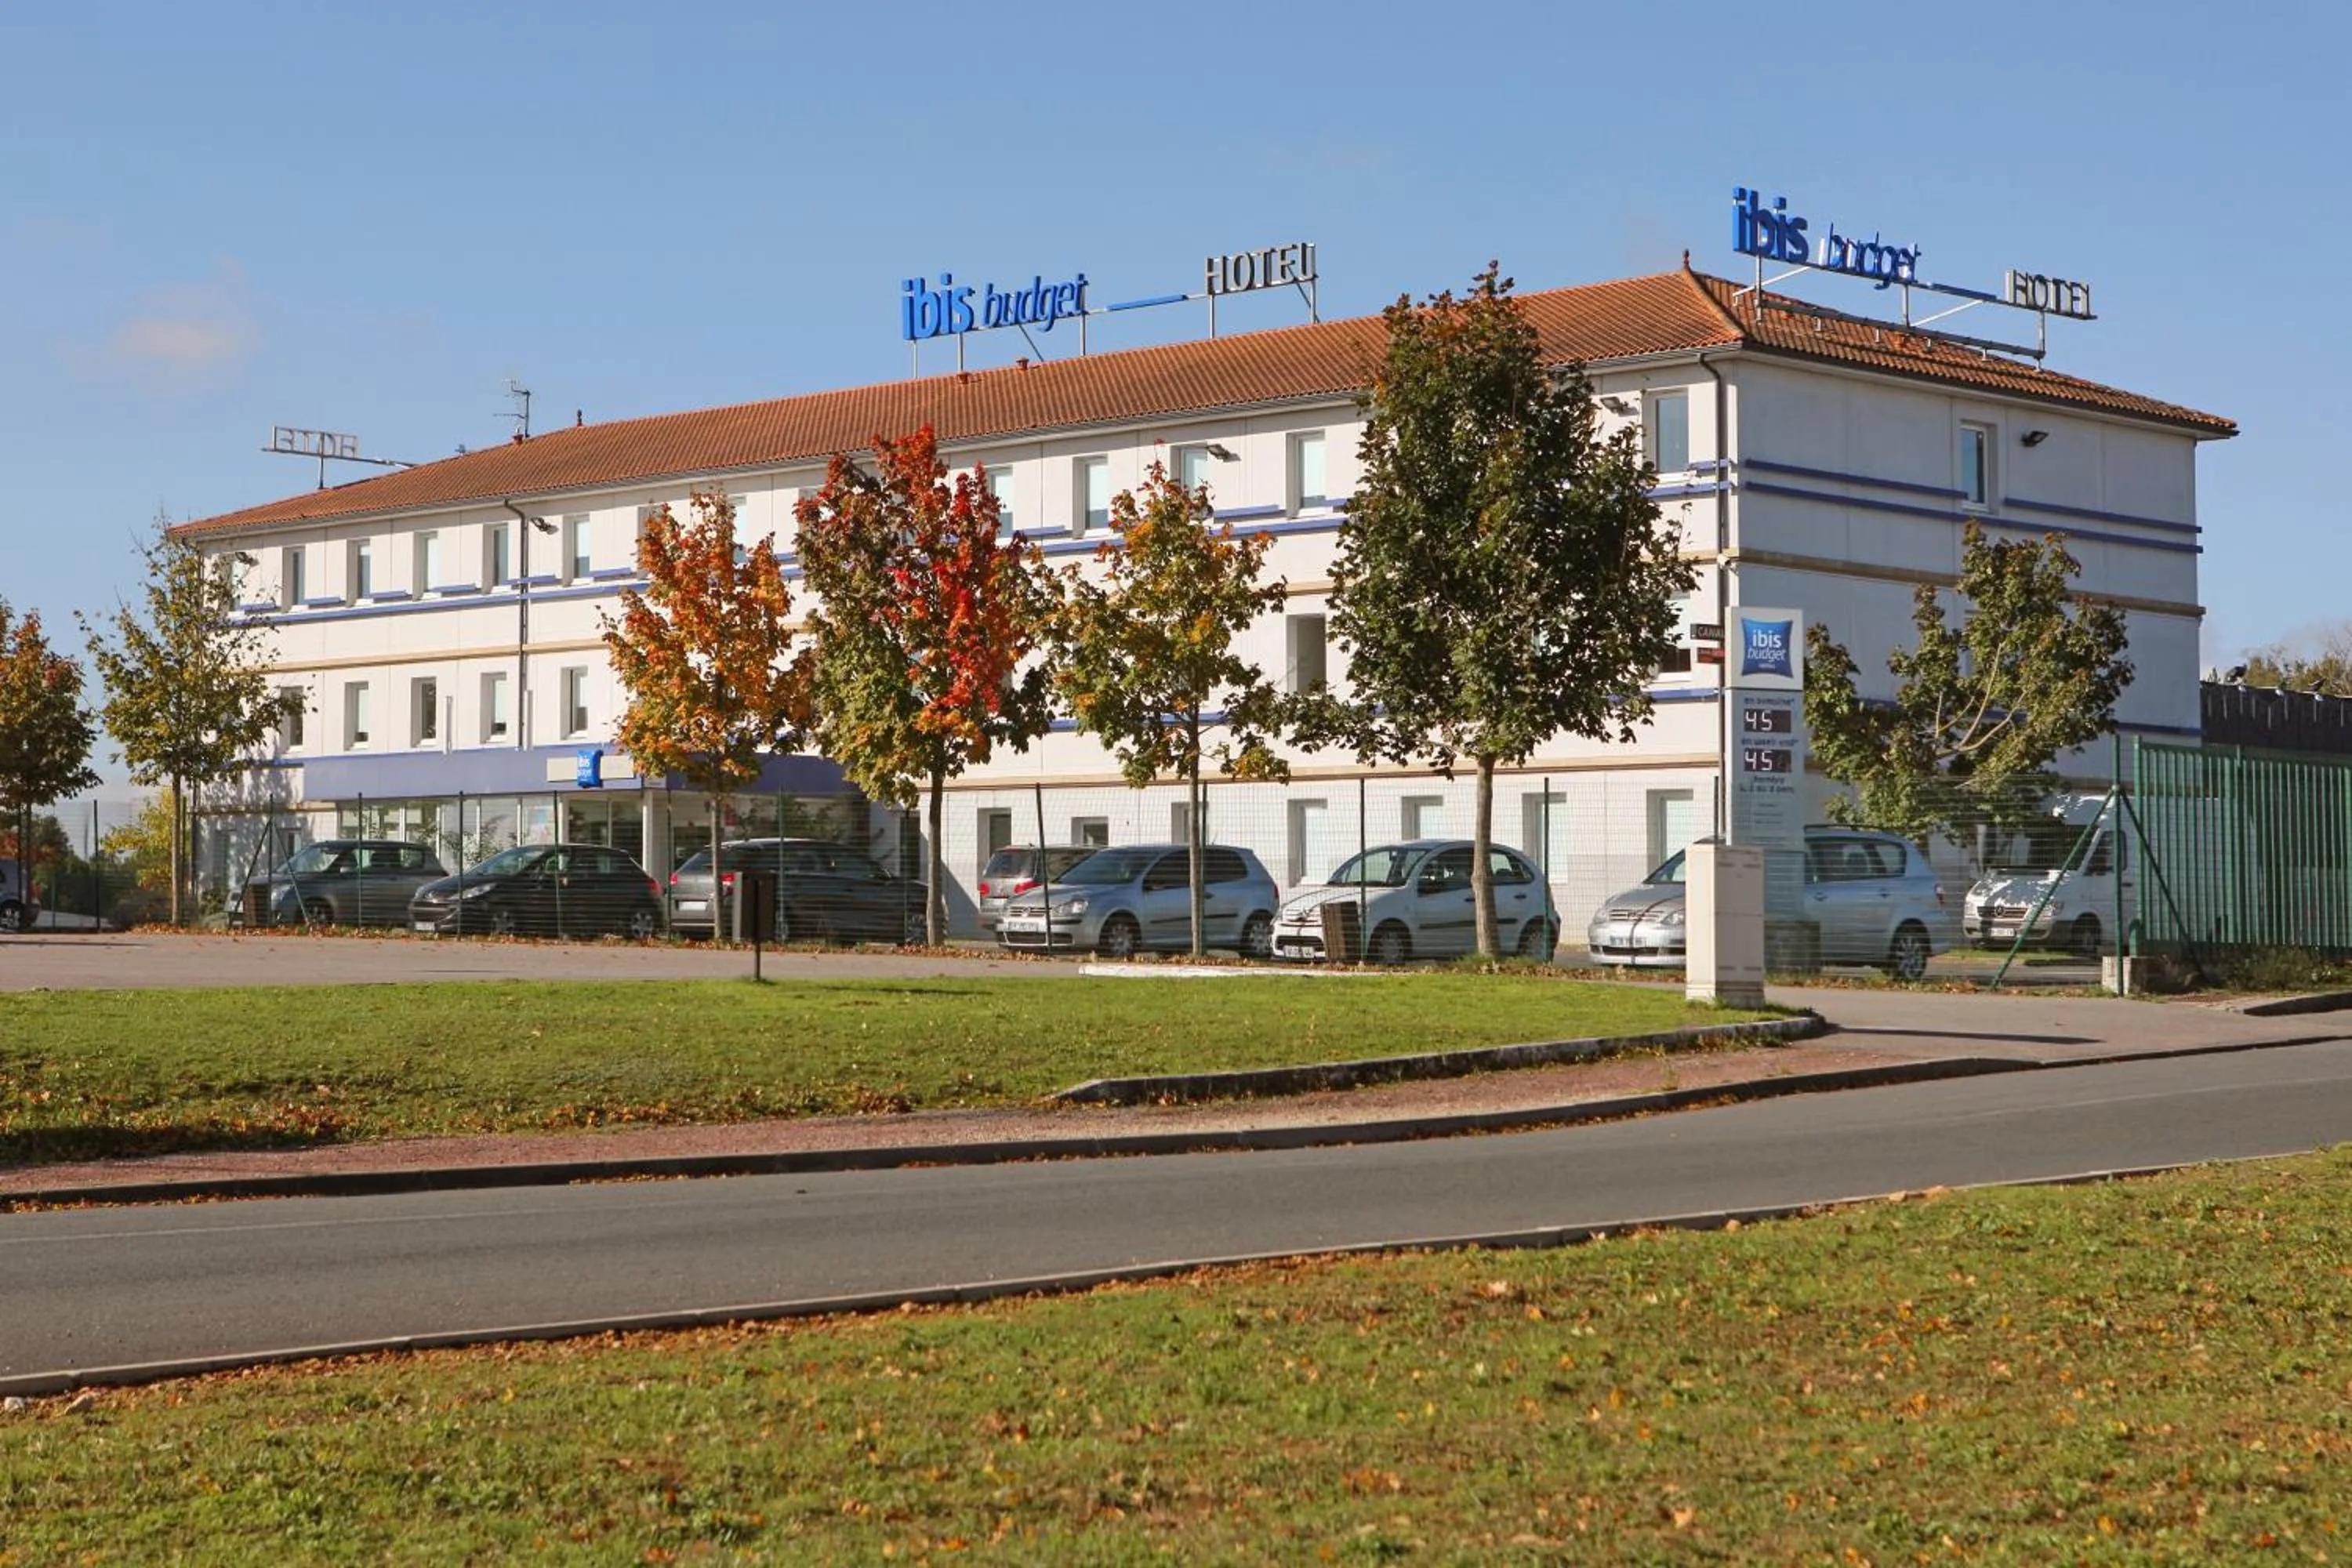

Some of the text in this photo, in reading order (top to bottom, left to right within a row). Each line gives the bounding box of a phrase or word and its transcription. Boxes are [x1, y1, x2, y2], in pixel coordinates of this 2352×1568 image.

[1733, 187, 1921, 290] ibis budget
[1205, 242, 1318, 295] HOTEL
[902, 273, 1088, 340] ibis budget
[2005, 269, 2096, 320] HOTEL
[1748, 648, 1786, 662] budget
[1752, 630, 1781, 648] ibis
[1745, 710, 1773, 731] 45
[1745, 750, 1773, 771] 45
